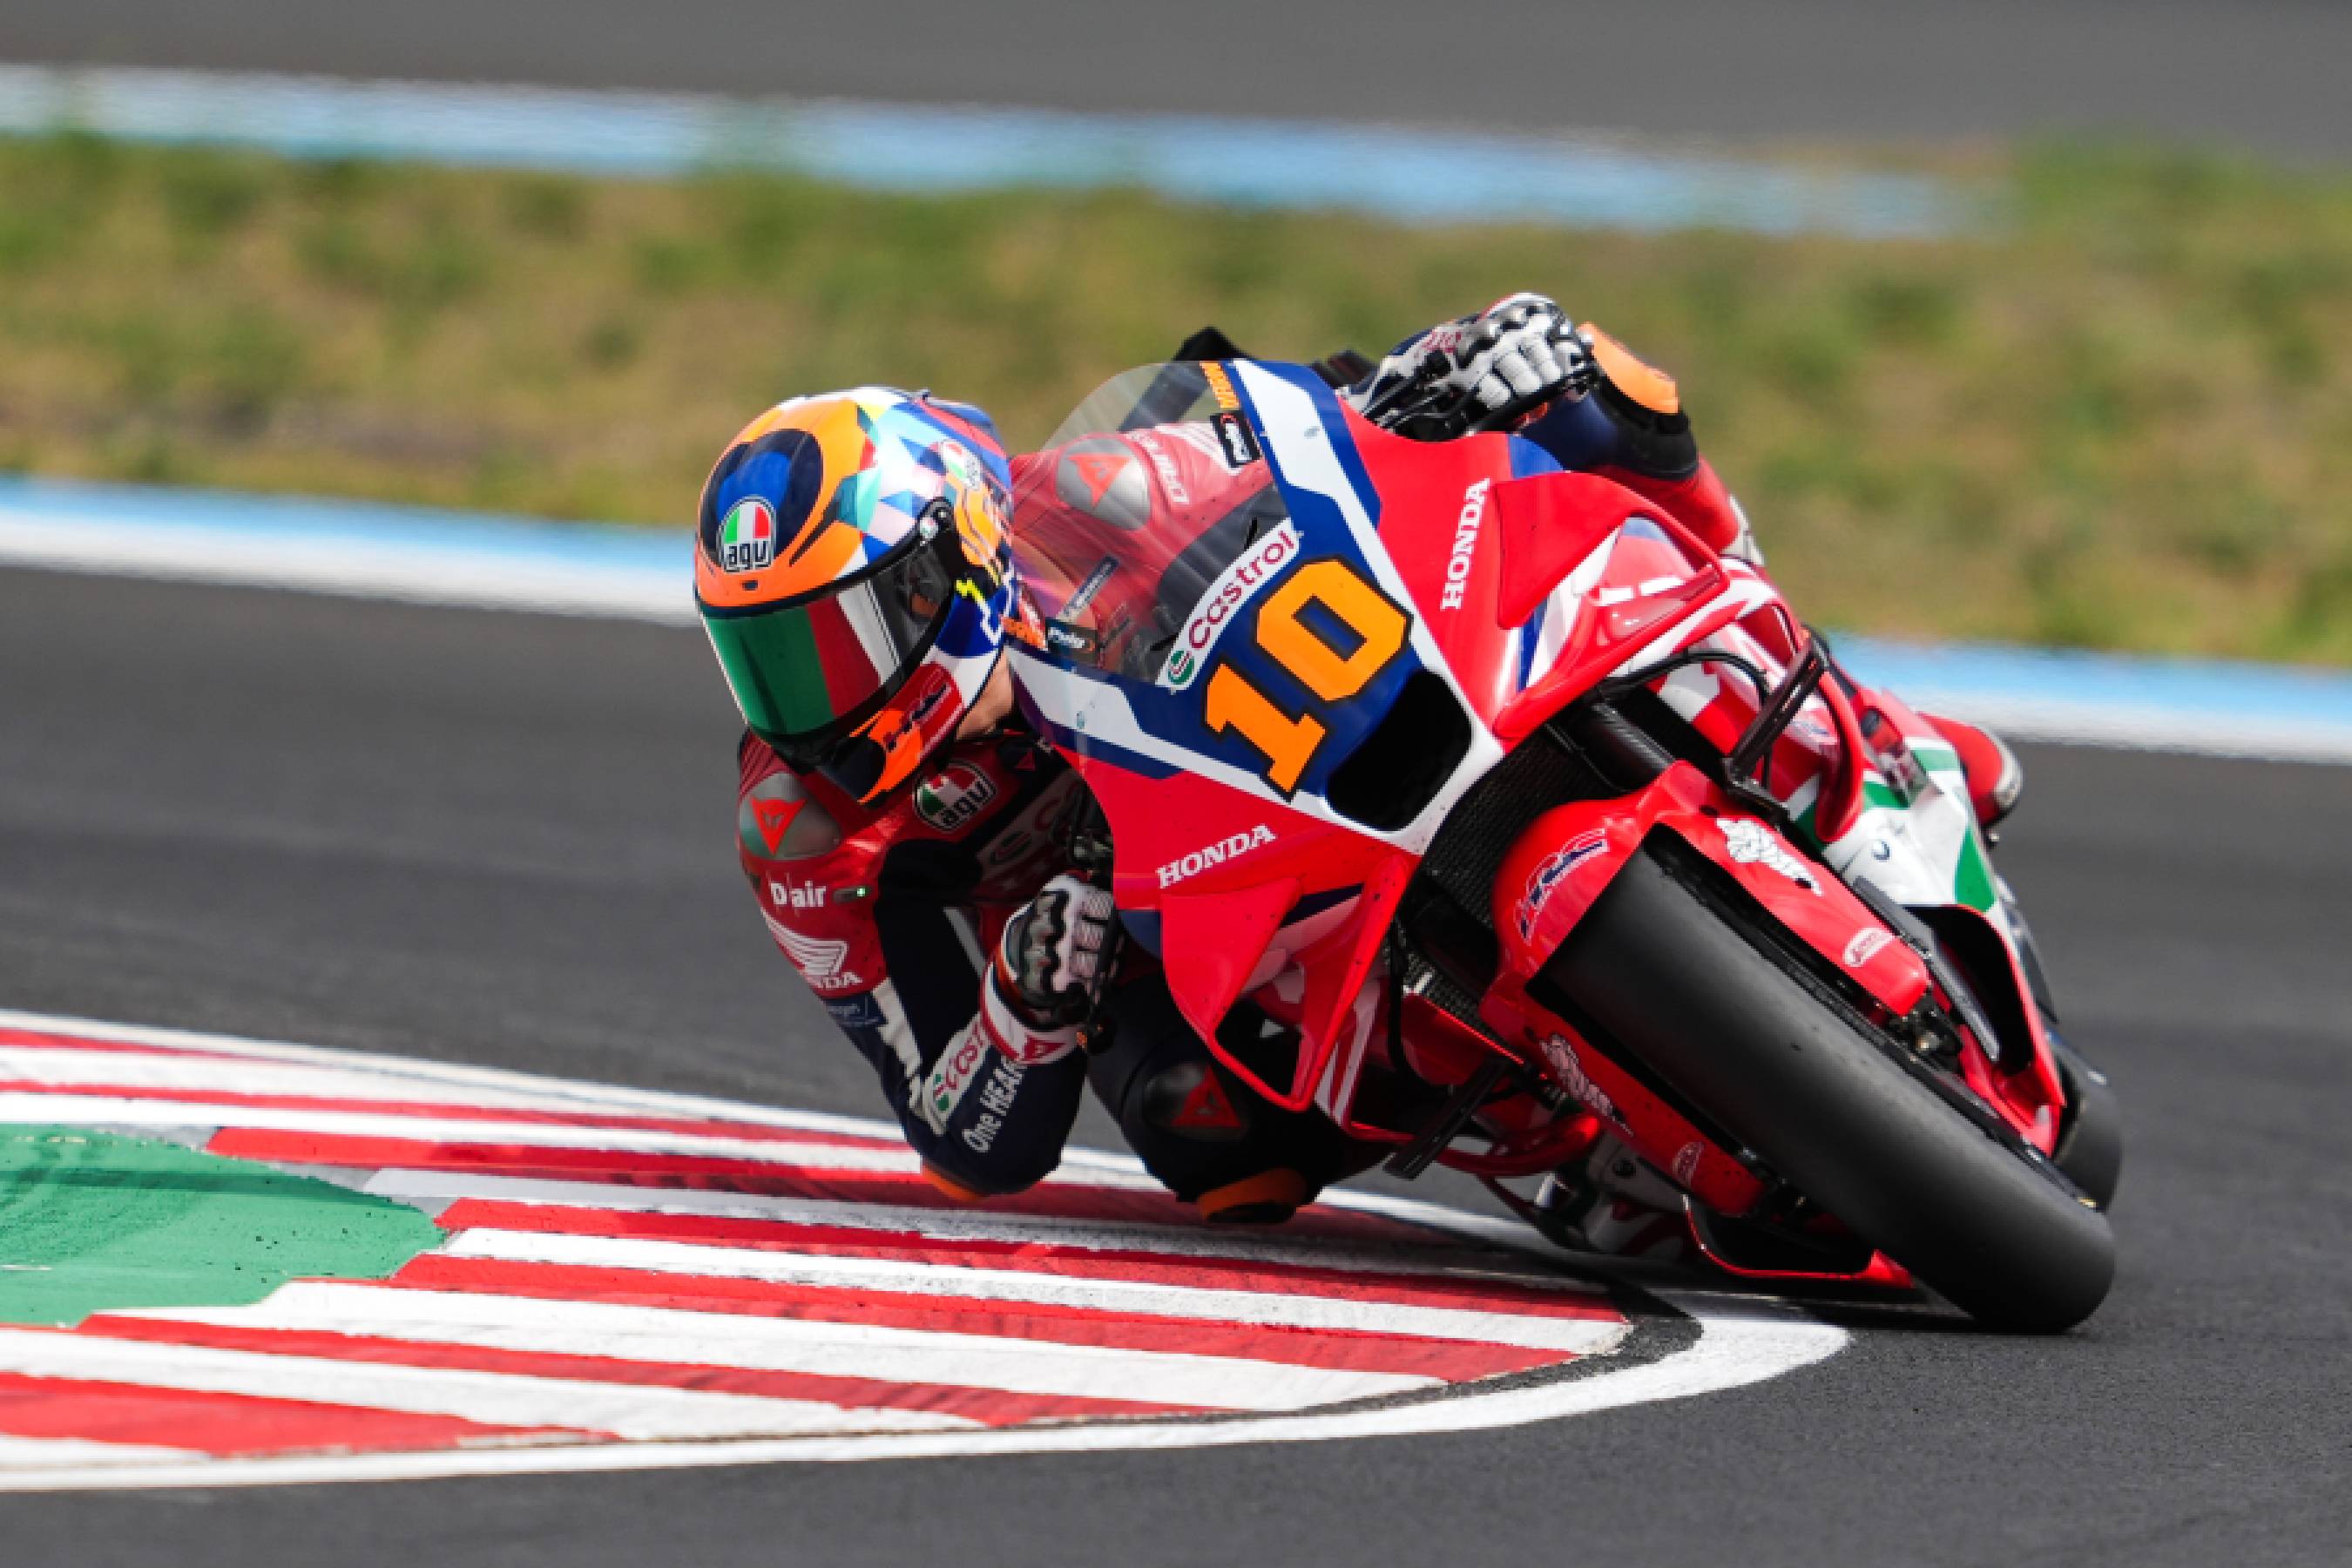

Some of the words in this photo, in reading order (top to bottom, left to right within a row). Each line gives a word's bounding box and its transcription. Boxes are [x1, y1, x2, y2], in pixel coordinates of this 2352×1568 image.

[727, 540, 768, 571] agv
[1439, 476, 1491, 612] HONDA
[1189, 530, 1294, 651] Castrol
[1205, 558, 1410, 796] 10
[1155, 823, 1278, 889] HONDA
[980, 1058, 1026, 1117] HEAR
[961, 1112, 1002, 1153] One
